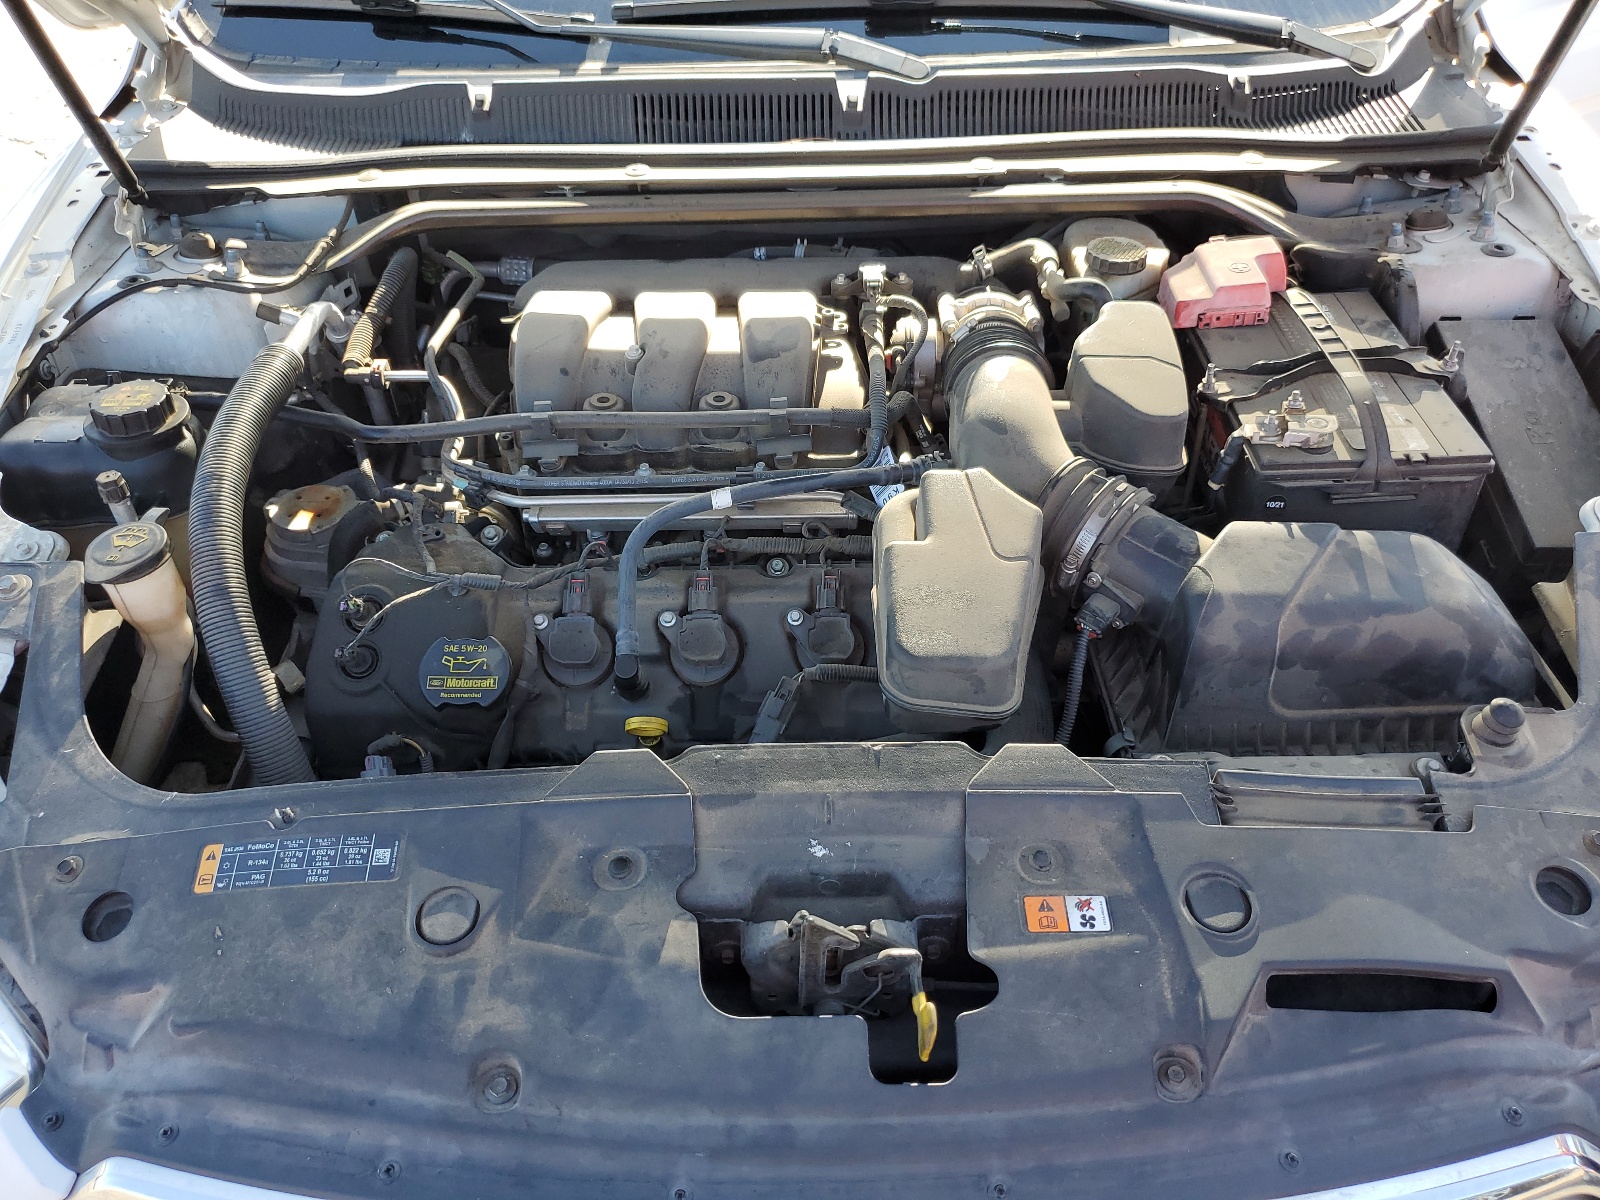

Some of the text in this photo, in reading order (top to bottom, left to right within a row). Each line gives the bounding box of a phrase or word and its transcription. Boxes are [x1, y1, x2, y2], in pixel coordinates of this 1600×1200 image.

[443, 644, 488, 652] SAE 5W-20
[446, 678, 496, 688] Motorcraft
[247, 842, 275, 850] FoMoCo
[247, 858, 269, 867] R-134a
[251, 873, 266, 881] PAG
[305, 875, 329, 884] (155 cc)
